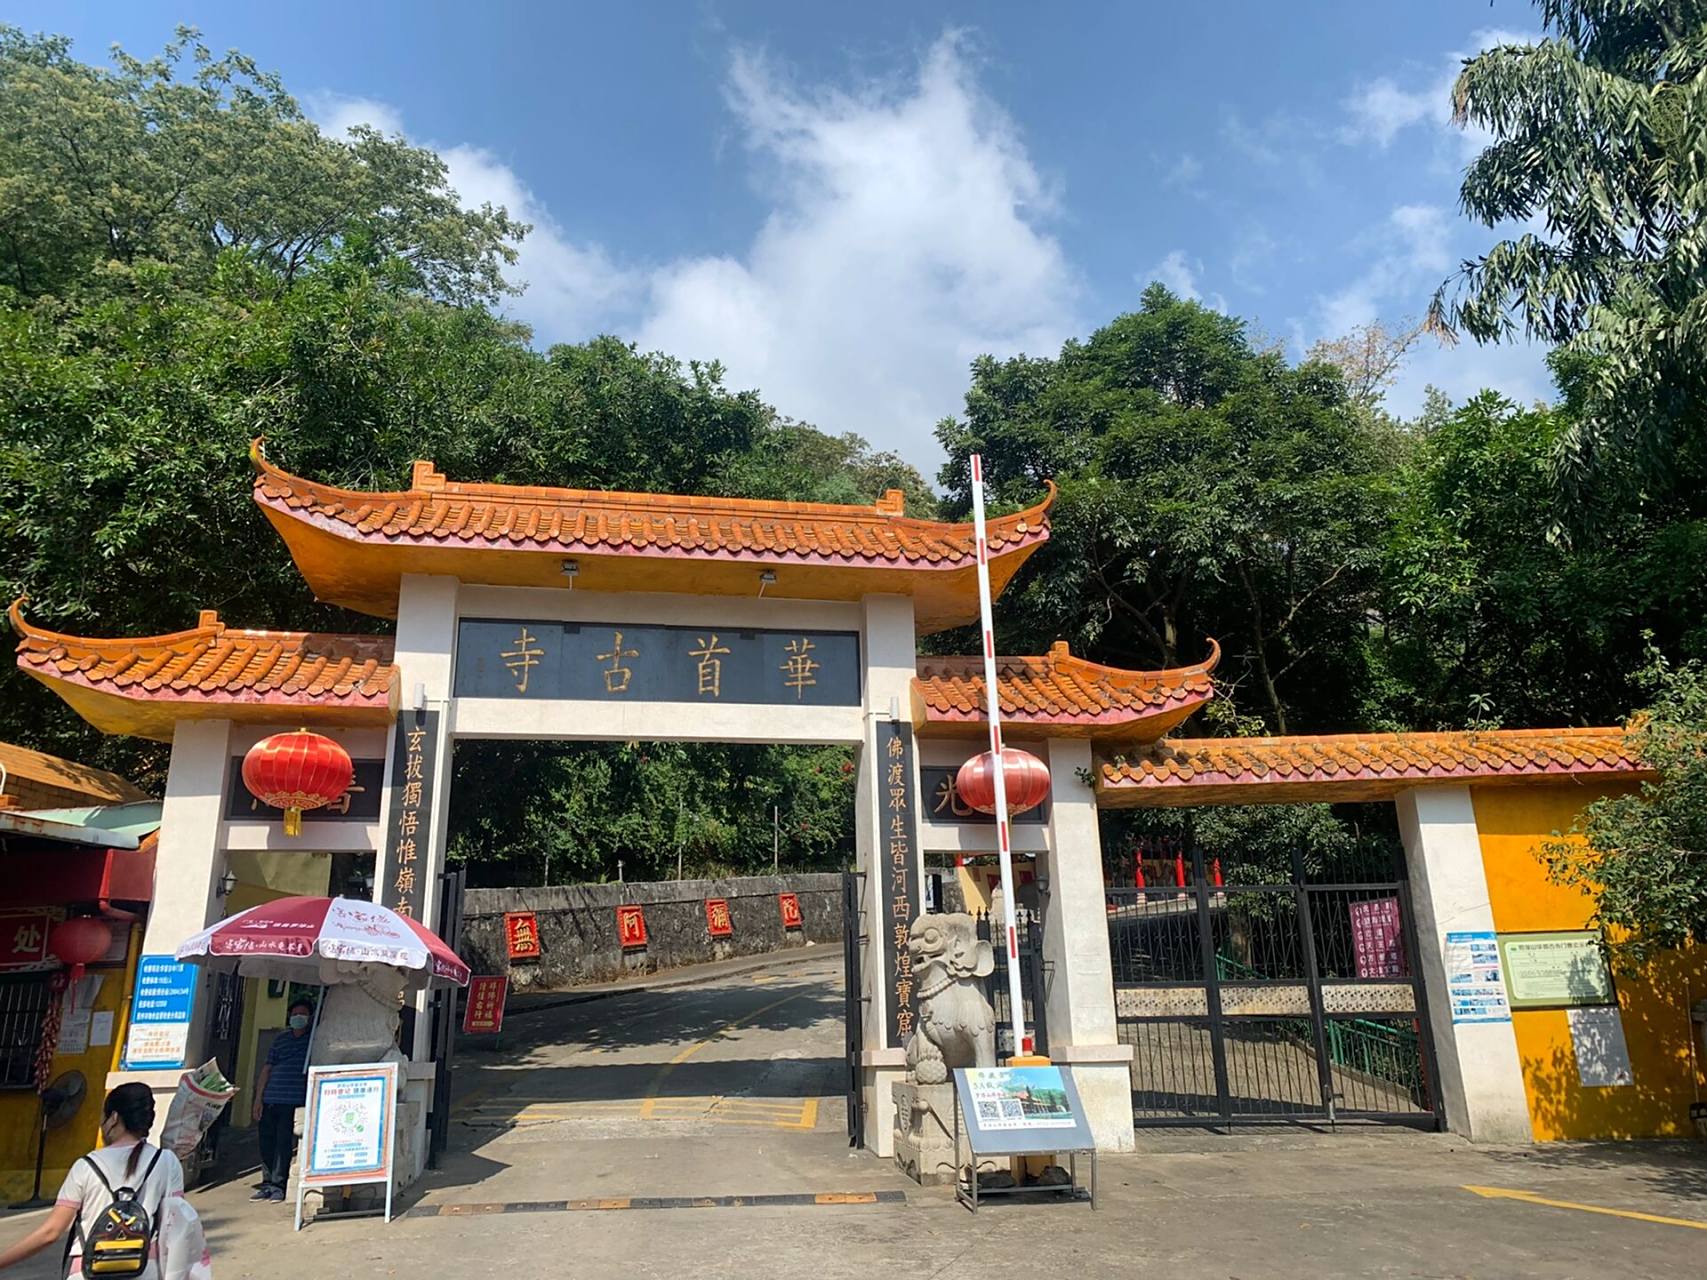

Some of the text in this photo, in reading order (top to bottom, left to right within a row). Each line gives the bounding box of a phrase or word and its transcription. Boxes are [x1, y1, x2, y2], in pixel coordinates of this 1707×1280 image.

[393, 726, 427, 919] 玄拔獨悟惟嶺南
[514, 918, 534, 952] 無
[622, 910, 641, 938] 阿
